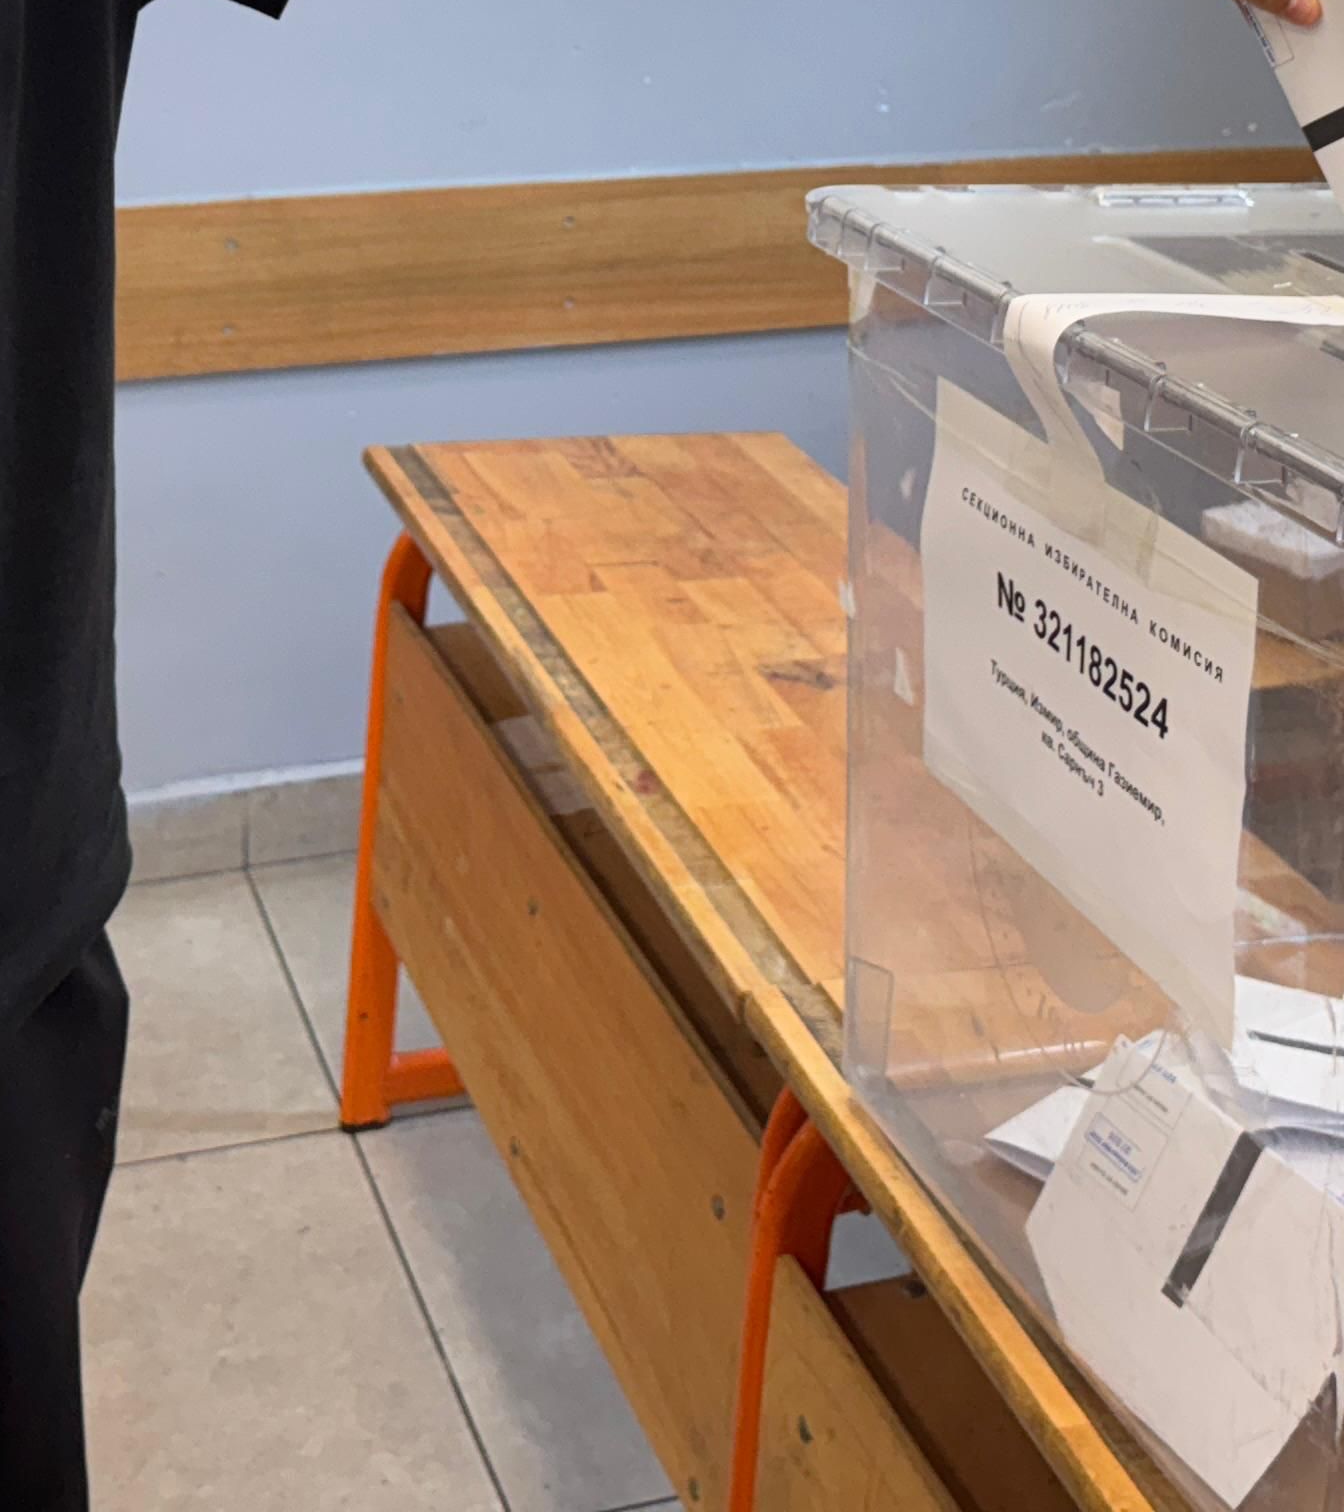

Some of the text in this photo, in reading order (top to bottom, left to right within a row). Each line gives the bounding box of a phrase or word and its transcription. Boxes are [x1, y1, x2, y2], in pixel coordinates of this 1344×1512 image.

[961, 487, 1225, 683] СЕКЦИОННА ИЗБИРАТЕЛНА КОМИСИЯ
[990, 659, 1028, 705] Турция,
[997, 571, 1170, 740] № 321182524
[1097, 779, 1105, 797] 3
